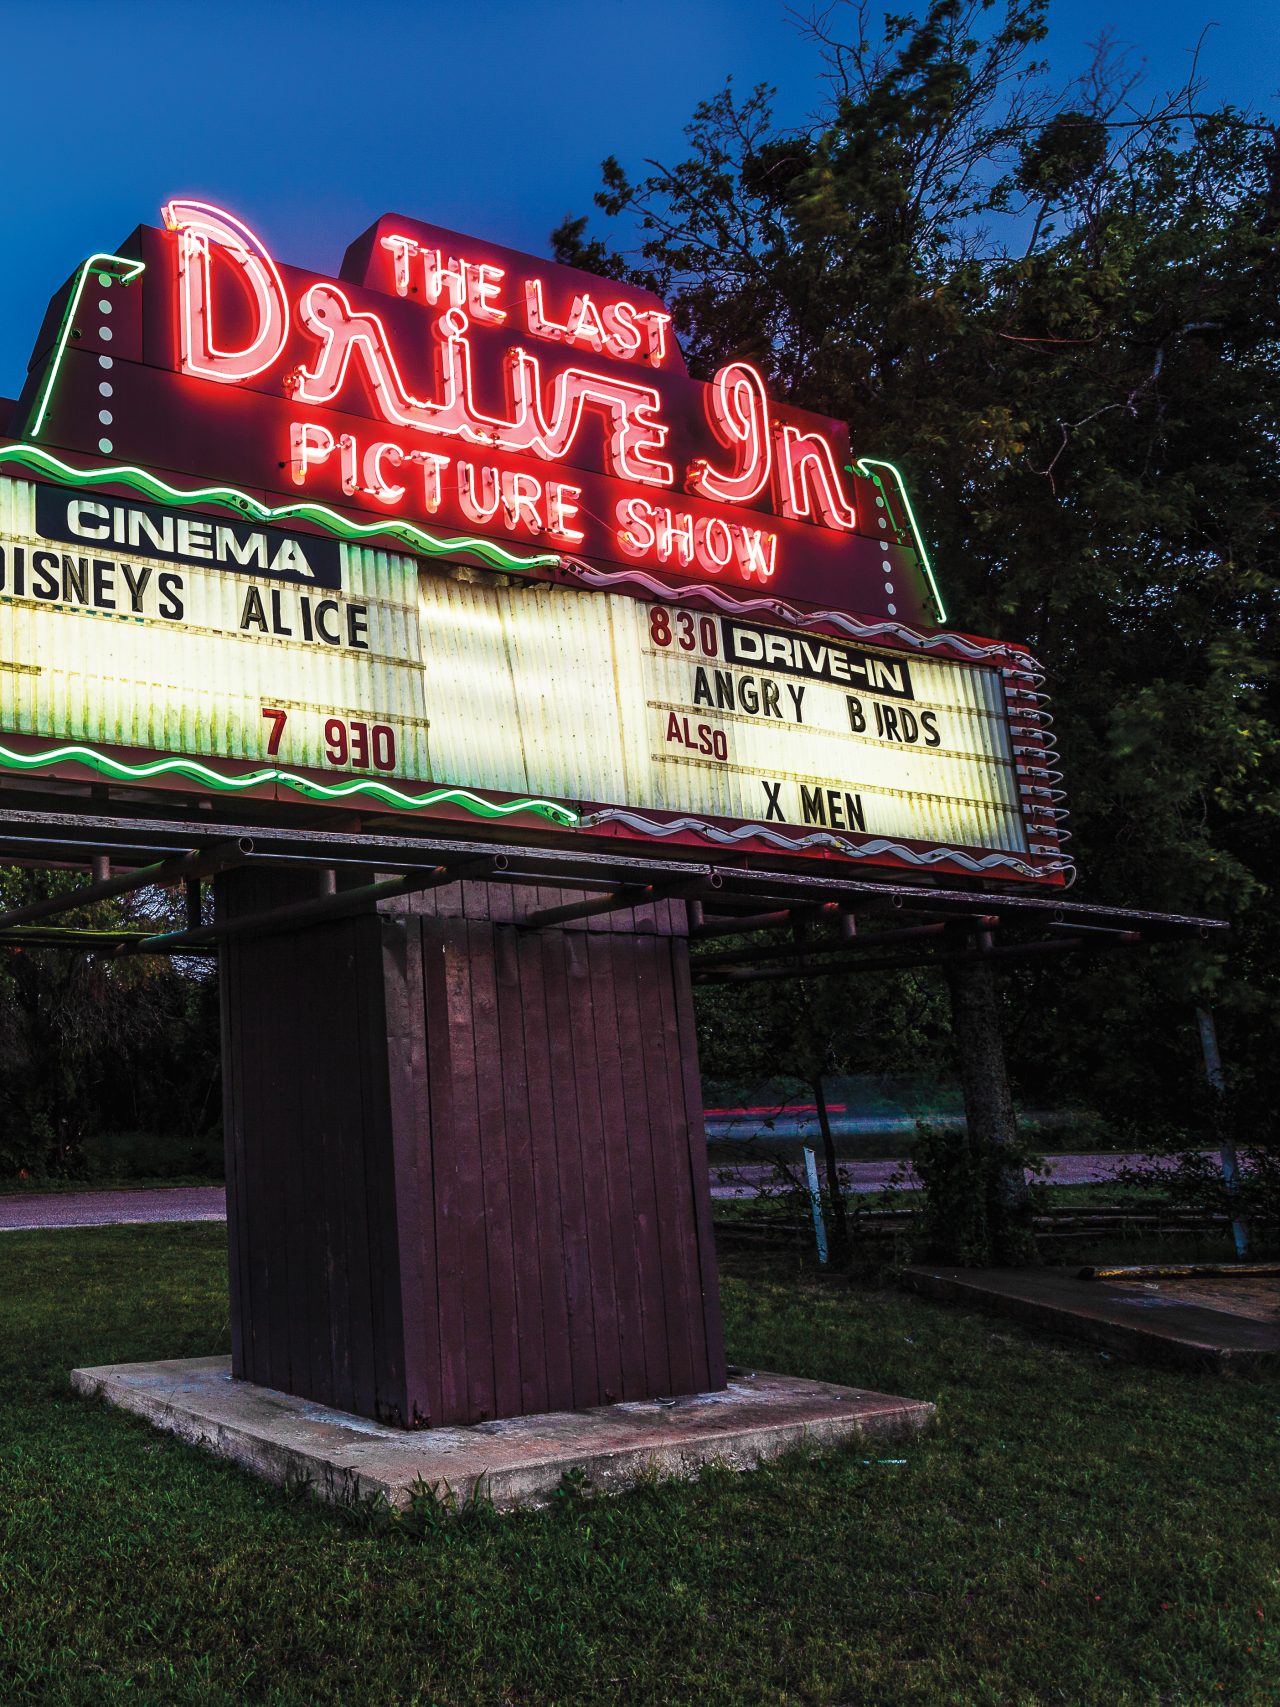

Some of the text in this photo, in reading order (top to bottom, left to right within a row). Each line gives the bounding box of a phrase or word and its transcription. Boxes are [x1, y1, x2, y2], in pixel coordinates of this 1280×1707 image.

[380, 233, 673, 367] THE LAST
[688, 363, 856, 528] In
[289, 421, 779, 581] PICTURE SHOW
[67, 499, 316, 578] CINEMA
[240, 585, 370, 649] ALICE
[650, 606, 719, 657] 830
[733, 627, 905, 693] DRIVE-IN
[693, 666, 806, 723] ANGRY
[262, 707, 288, 756] 7
[666, 711, 729, 761] ALSO
[761, 780, 867, 833] X MEN
